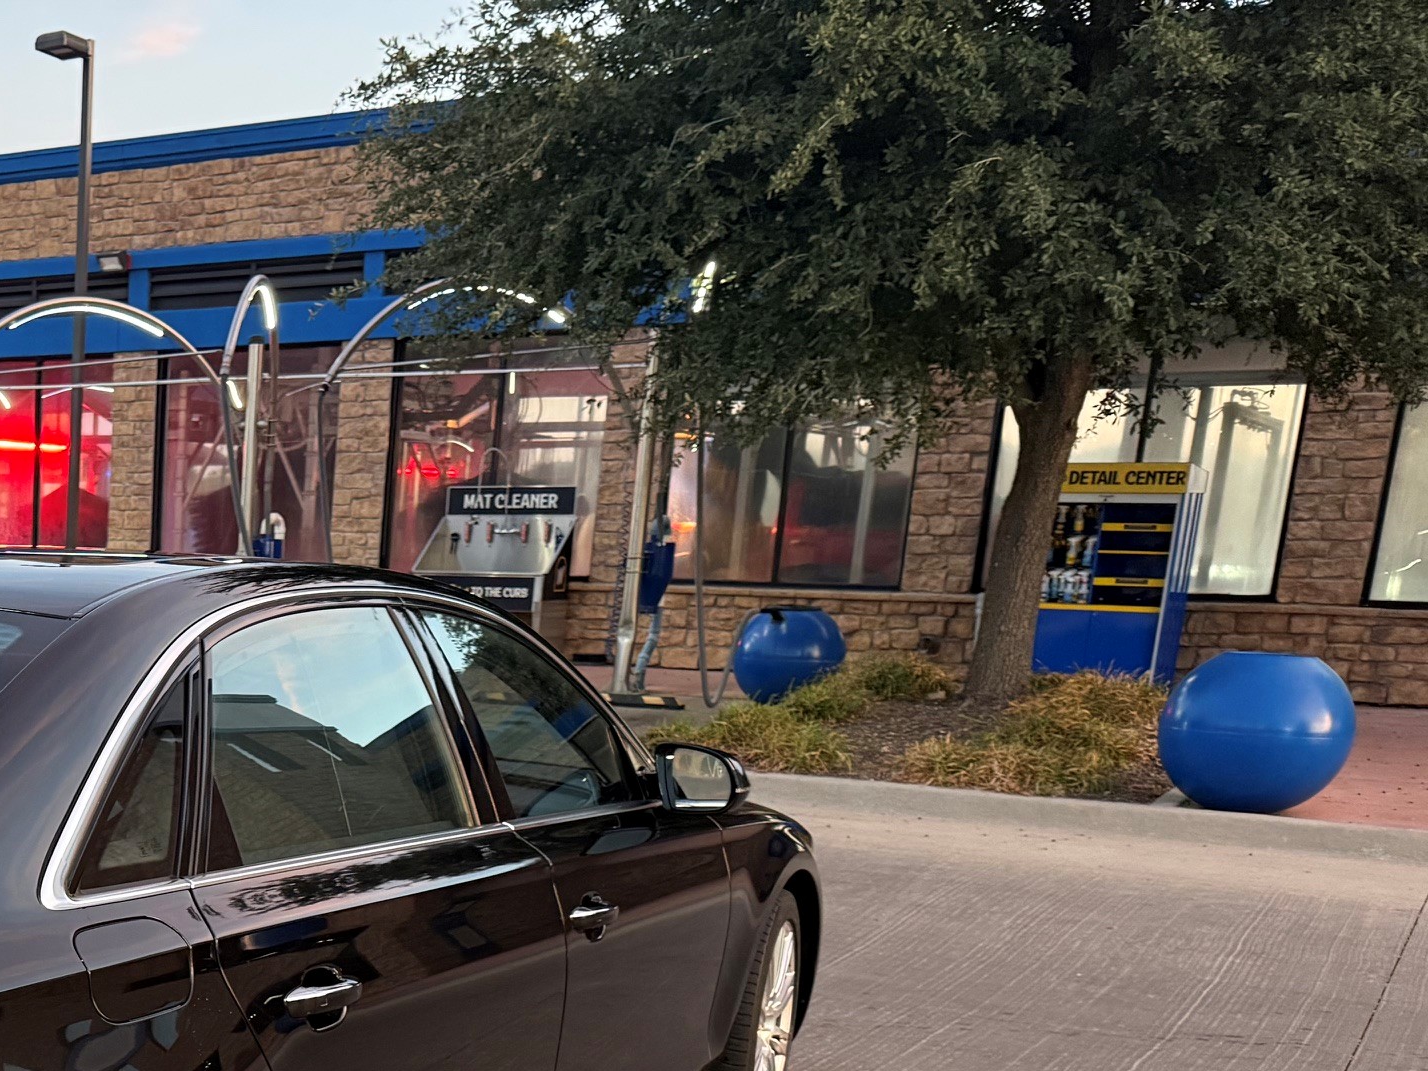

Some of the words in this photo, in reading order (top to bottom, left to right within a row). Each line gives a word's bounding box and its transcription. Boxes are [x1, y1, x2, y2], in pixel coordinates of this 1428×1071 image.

[1068, 470, 1121, 485] DETAIL
[1124, 470, 1186, 485] CENTER
[462, 494, 493, 510] MAT
[494, 493, 559, 509] CLEANER
[484, 586, 502, 598] THE
